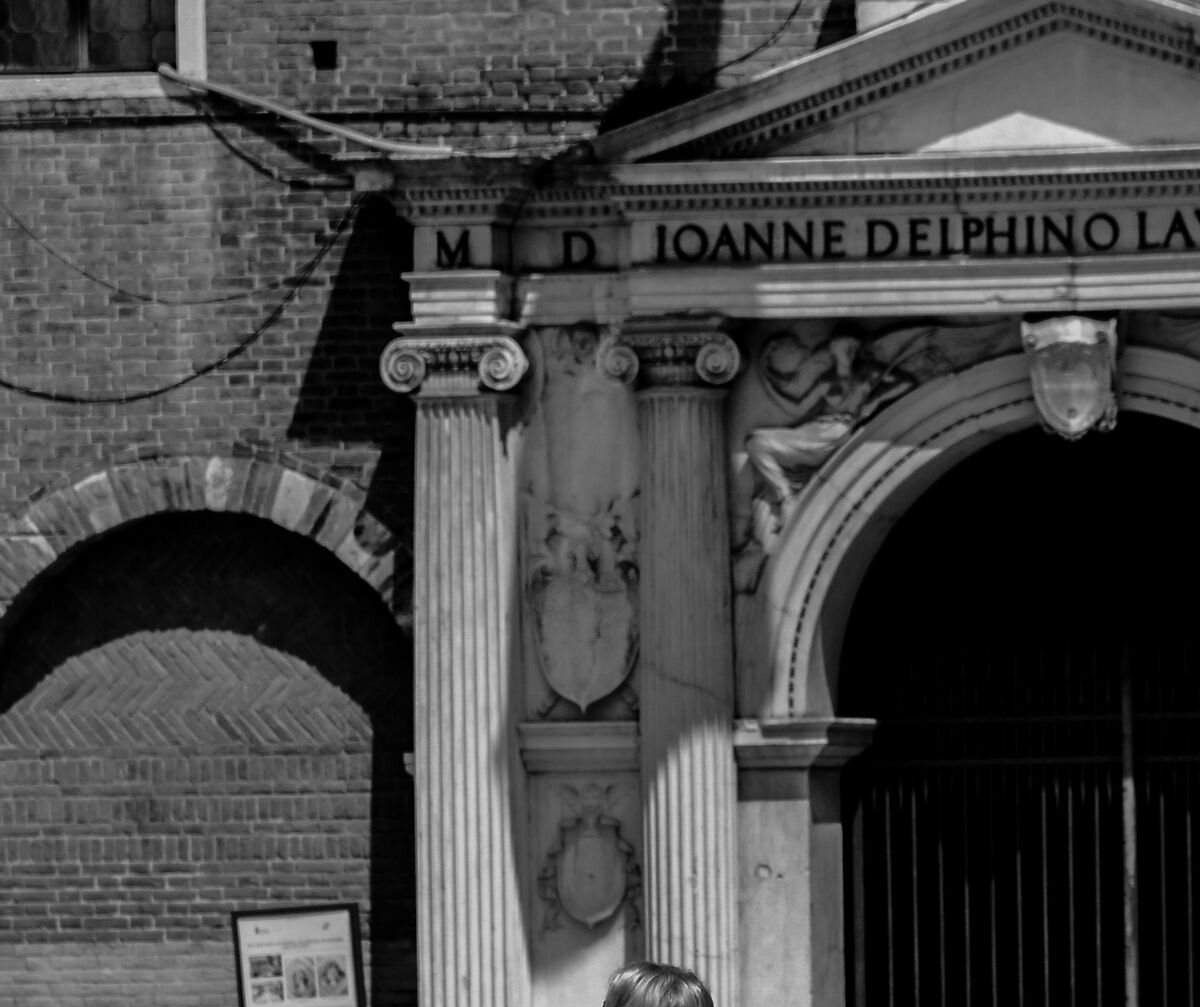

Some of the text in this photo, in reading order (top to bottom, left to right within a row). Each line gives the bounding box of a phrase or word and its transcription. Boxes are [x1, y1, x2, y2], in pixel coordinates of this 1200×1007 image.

[435, 208, 1200, 269] M D IOANNE DELPHINO LA
